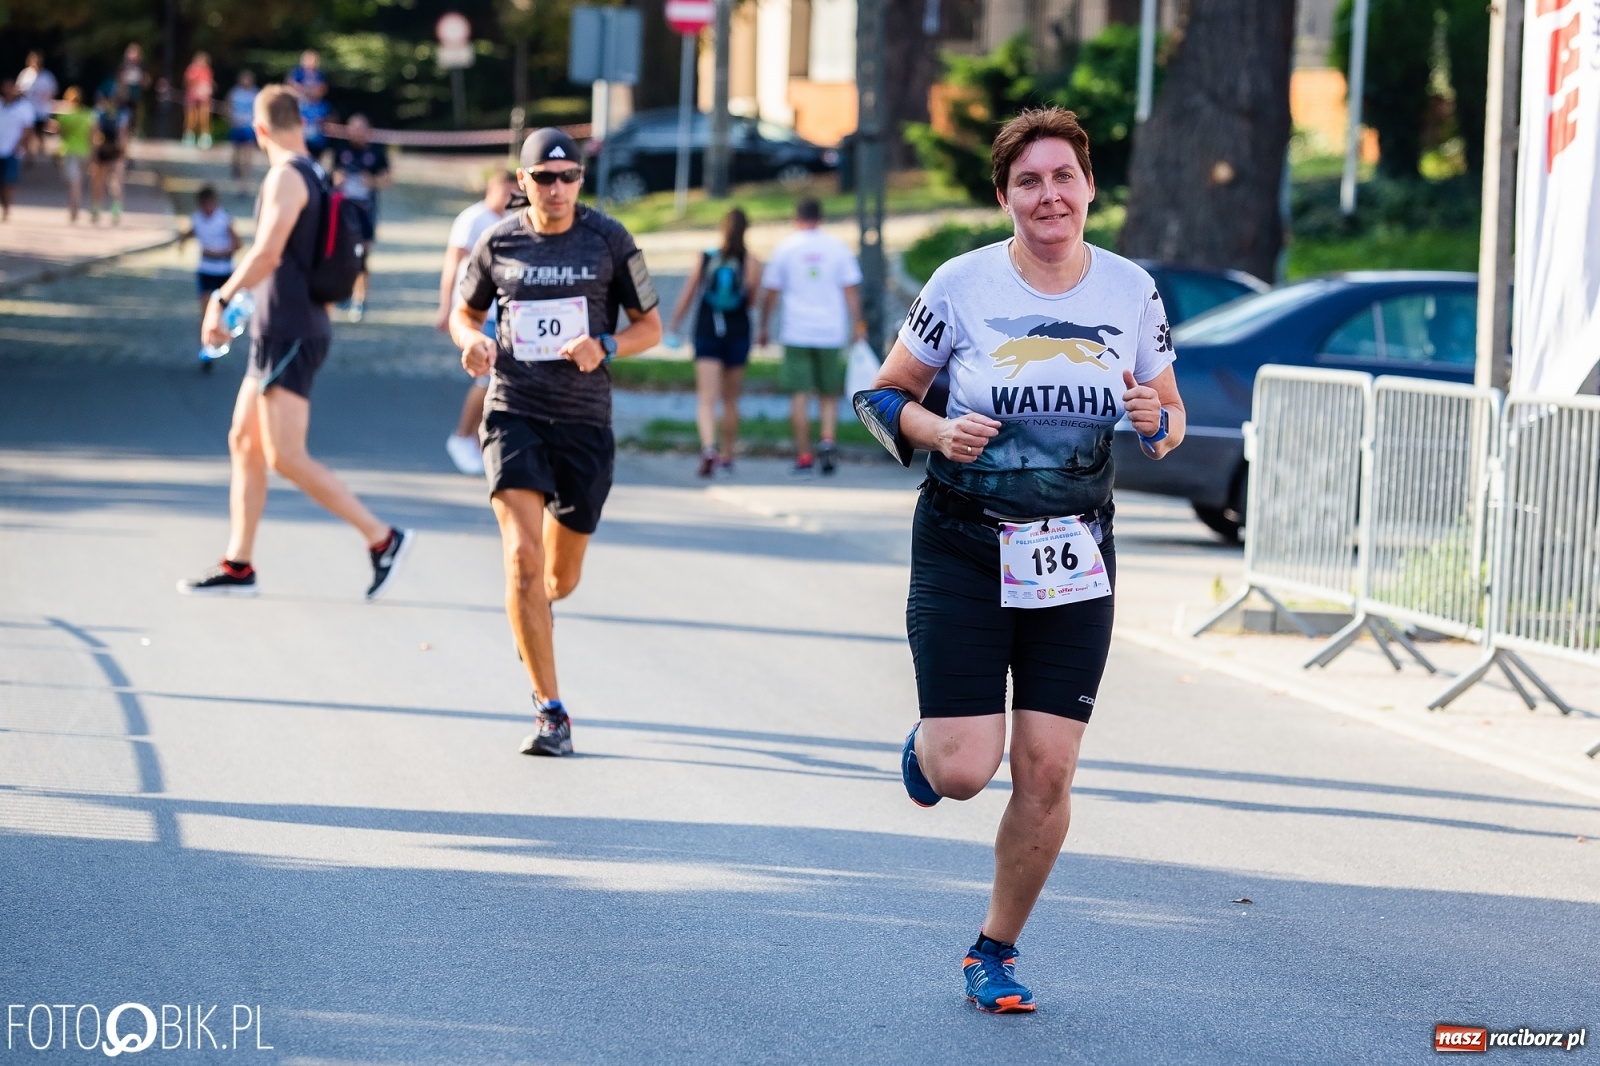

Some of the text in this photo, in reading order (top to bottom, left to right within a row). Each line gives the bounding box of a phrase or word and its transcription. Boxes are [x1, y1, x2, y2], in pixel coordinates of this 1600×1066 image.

[504, 266, 597, 280] PITBULL
[538, 319, 561, 337] 50
[991, 385, 1117, 417] WATAHA
[1033, 419, 1058, 427] NAS
[1031, 542, 1079, 576] 136
